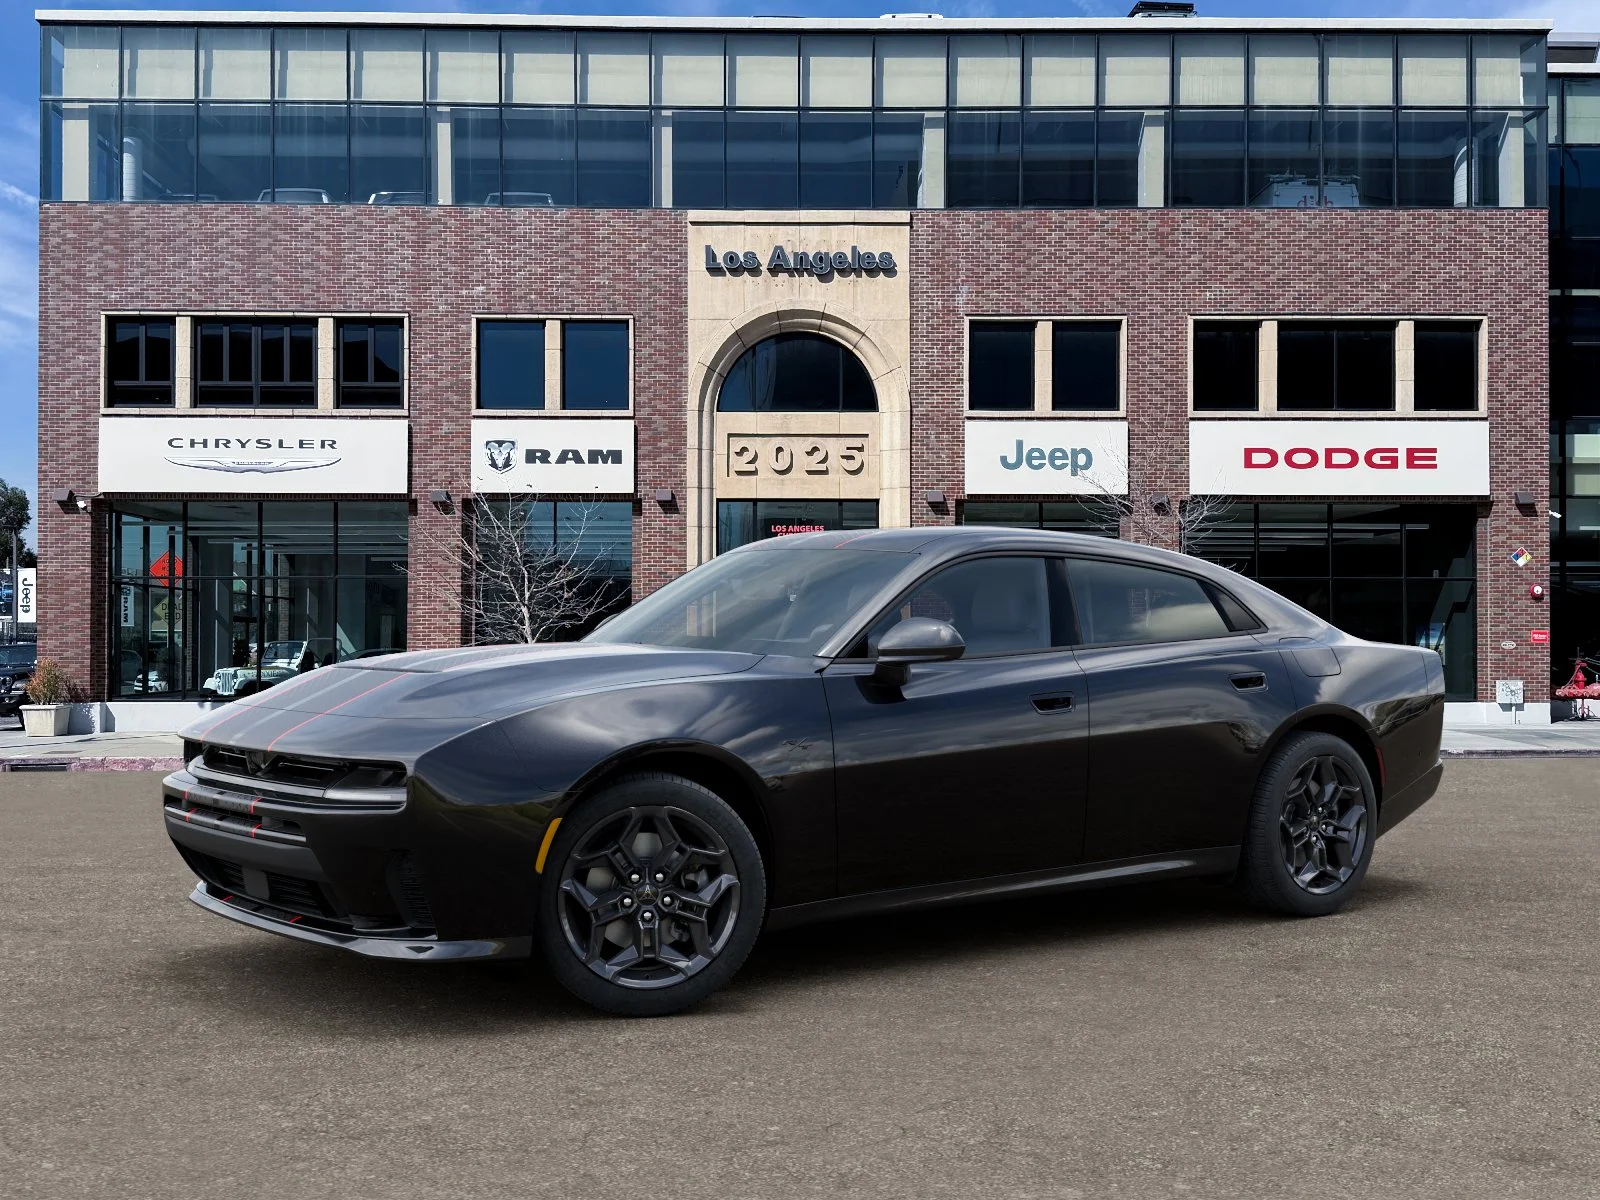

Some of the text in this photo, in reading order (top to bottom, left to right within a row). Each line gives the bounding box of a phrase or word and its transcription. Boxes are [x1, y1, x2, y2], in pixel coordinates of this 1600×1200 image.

[705, 245, 895, 275] Los Angeles
[167, 437, 338, 450] CHRYSLER
[525, 448, 623, 465] RAM
[734, 441, 865, 476] 2025
[999, 439, 1093, 477] Jeep
[1243, 447, 1438, 470] DODGE
[20, 578, 34, 613] Jeep
